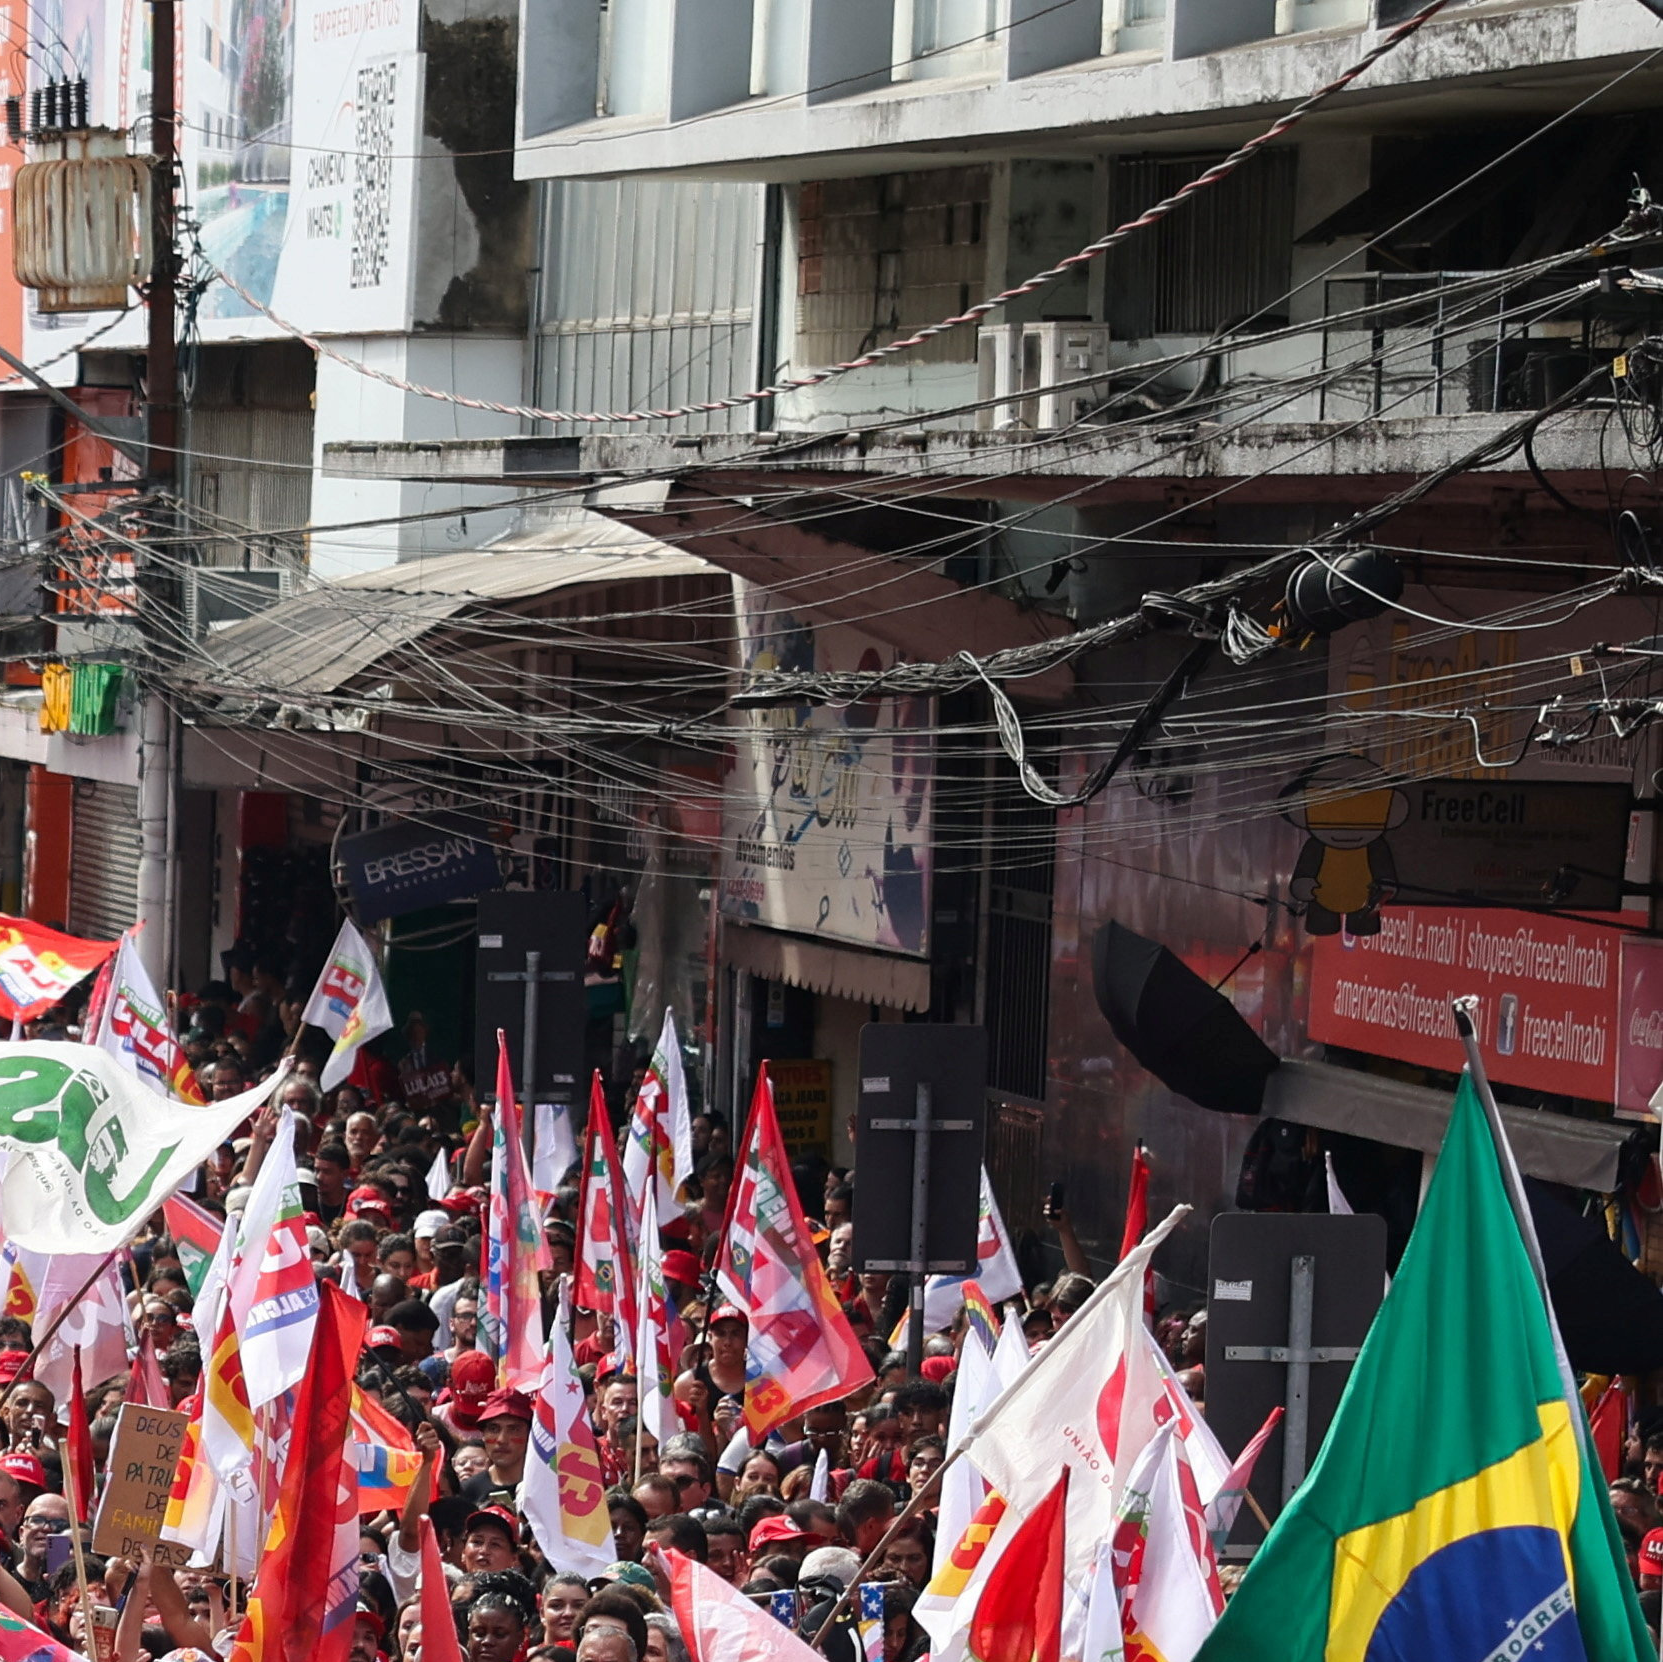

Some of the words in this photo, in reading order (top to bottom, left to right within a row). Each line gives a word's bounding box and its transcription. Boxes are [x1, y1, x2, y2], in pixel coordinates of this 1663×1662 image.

[313, 1, 400, 42] EMPREENDIMENTOS
[1421, 790, 1526, 825] FreeCell
[1467, 925, 1609, 989] shopee@freecellmabi
[1522, 1004, 1607, 1067] freecellmabi
[402, 1075, 446, 1098] LULA13
[136, 1415, 181, 1439] DEUS
[4, 1456, 33, 1471] LULA
[1062, 1424, 1101, 1472] UNIÃO
